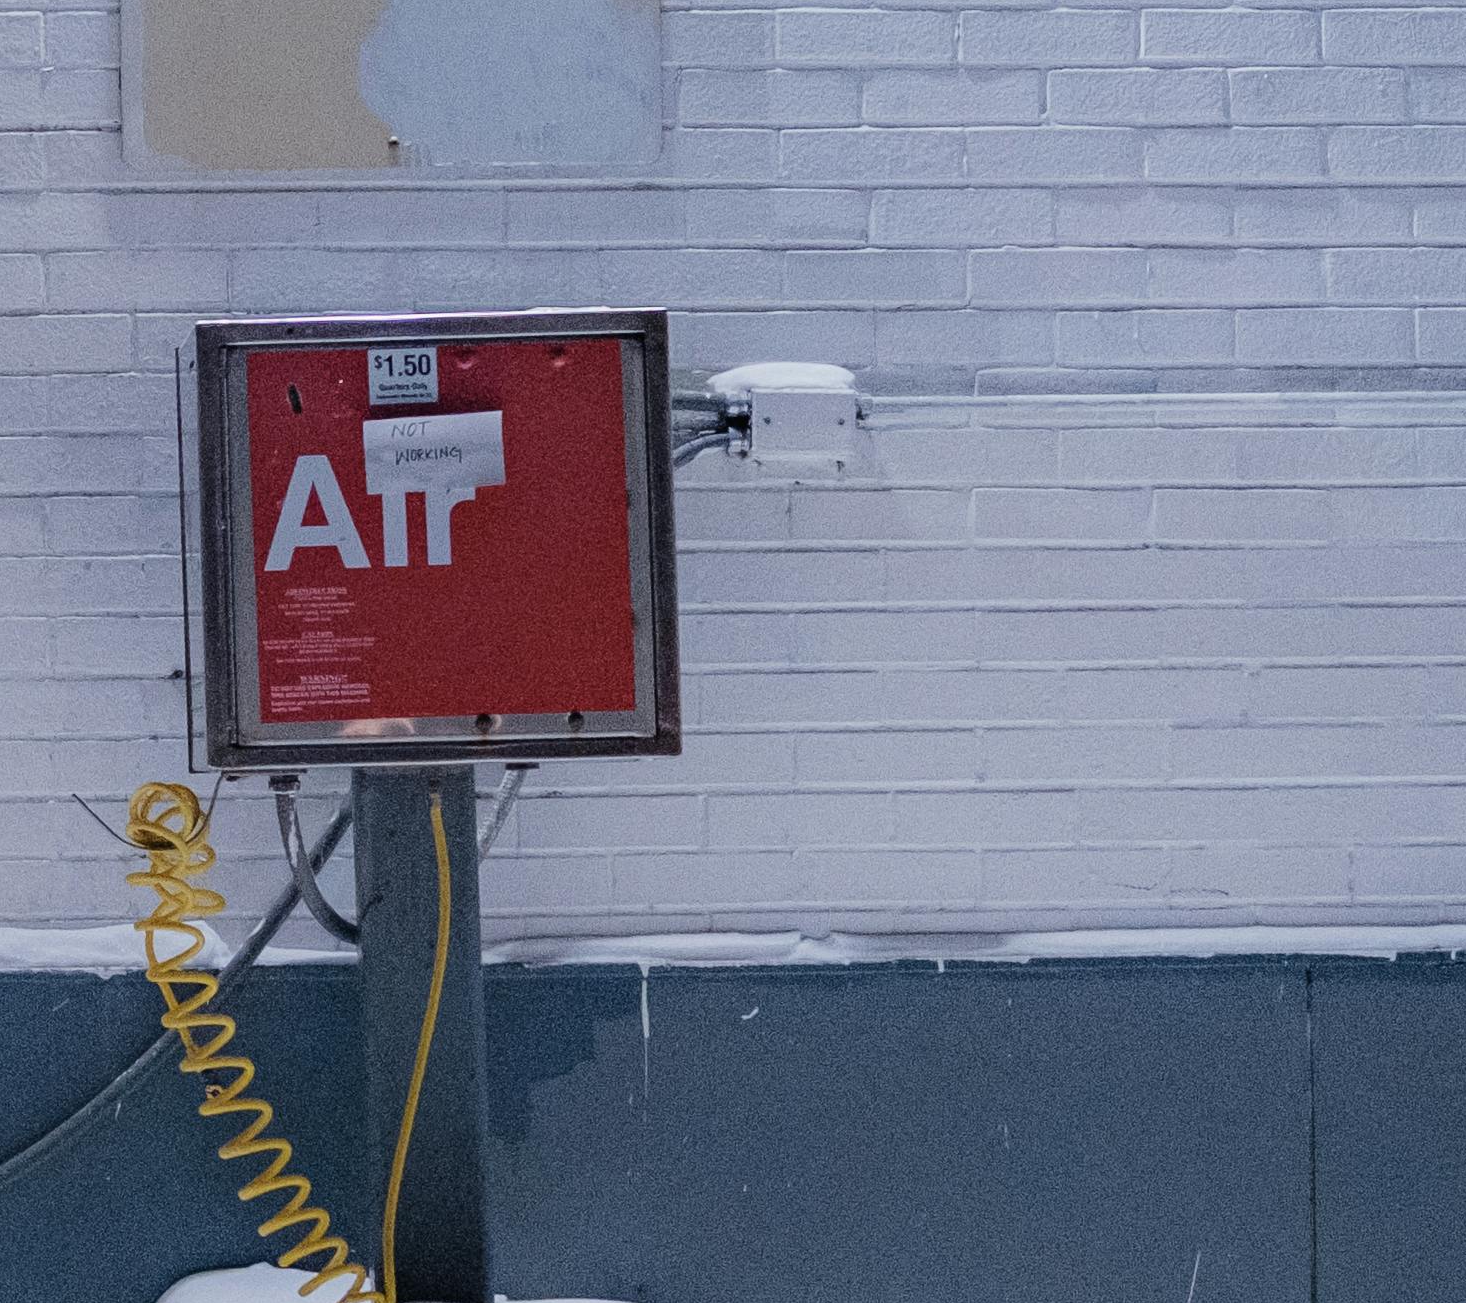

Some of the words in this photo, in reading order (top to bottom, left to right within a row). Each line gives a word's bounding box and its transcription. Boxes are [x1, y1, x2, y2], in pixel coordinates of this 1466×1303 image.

[374, 354, 431, 377] $1.50
[391, 421, 430, 437] NOT
[395, 446, 462, 465] WORKING
